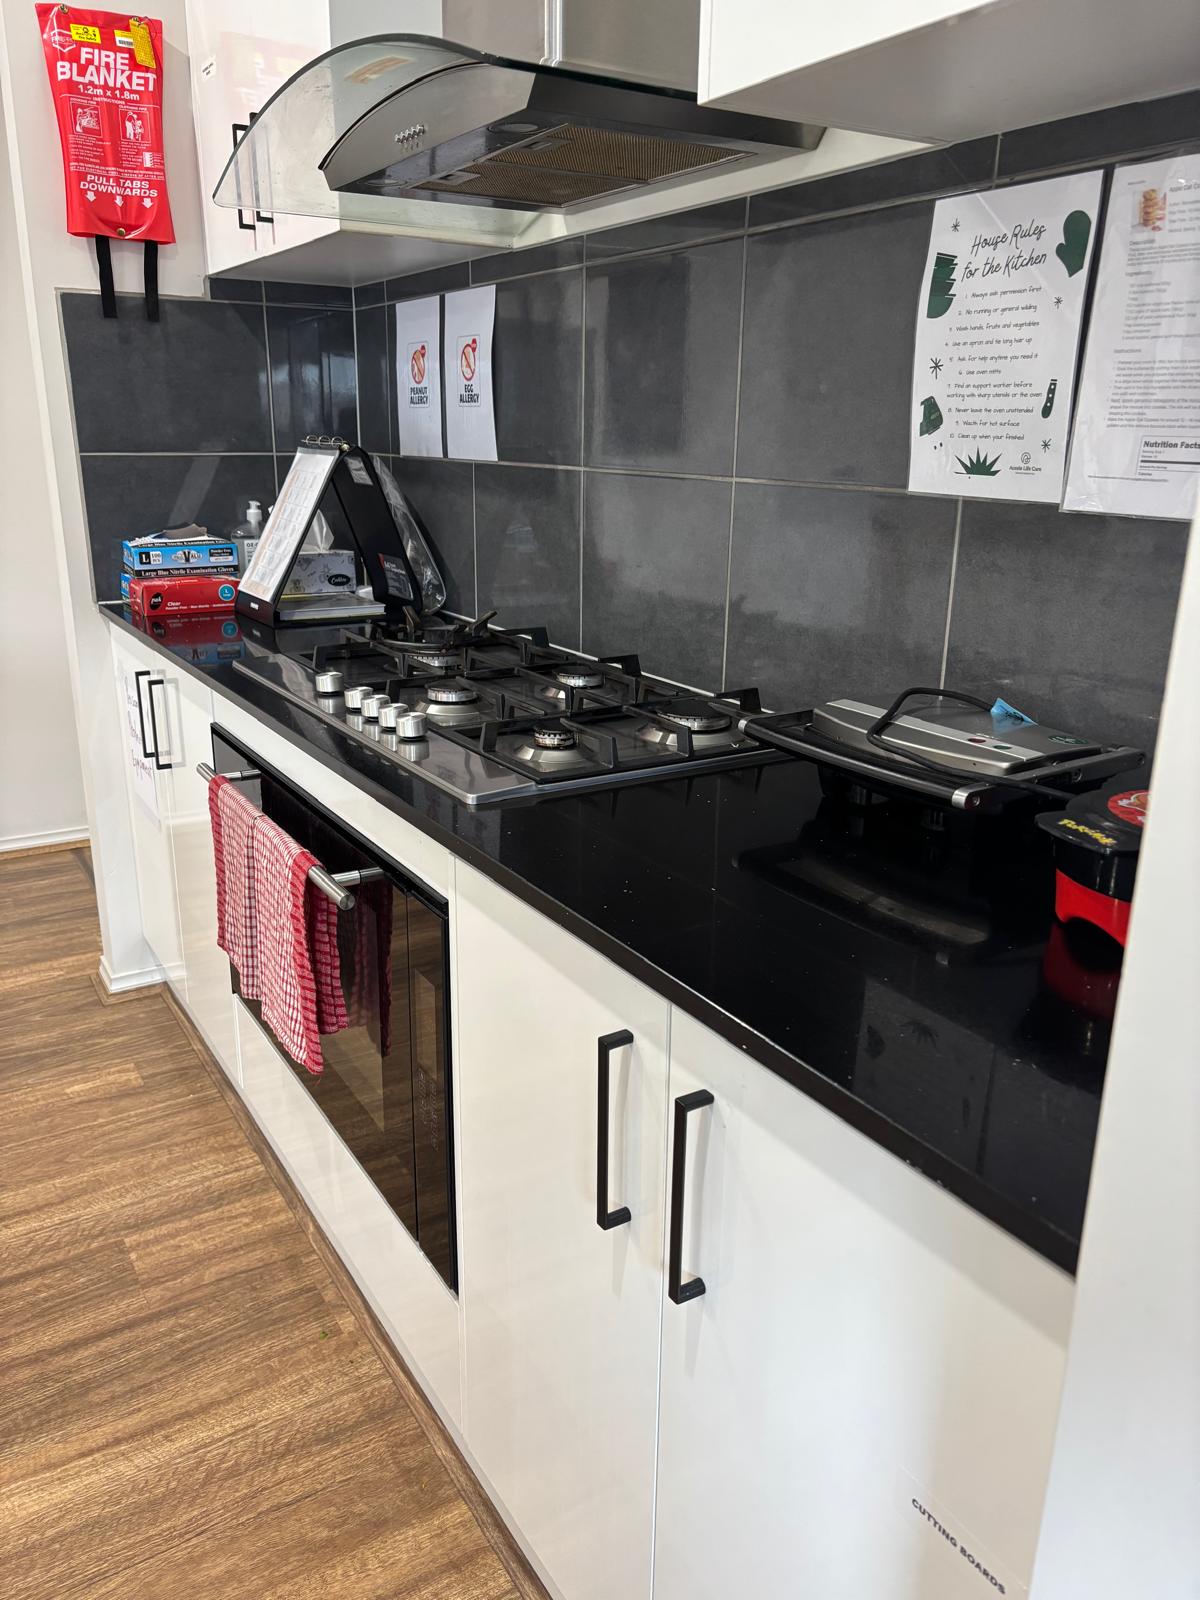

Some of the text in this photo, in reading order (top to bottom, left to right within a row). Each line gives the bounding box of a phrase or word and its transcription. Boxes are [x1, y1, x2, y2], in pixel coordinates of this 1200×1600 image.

[80, 47, 130, 70] FIRE
[56, 61, 156, 92] BLANKET
[78, 84, 103, 96] 1.2m
[115, 90, 140, 101] 1.8m
[86, 174, 149, 188] PULL TABS
[80, 181, 158, 197] DOWNWARDS
[970, 219, 1046, 256] House Rules
[961, 248, 1047, 282] for the Kitchen
[974, 308, 992, 316] running
[968, 354, 977, 362] for
[978, 355, 988, 363] help
[1010, 354, 1019, 363] you
[1020, 352, 1034, 360] need
[464, 384, 474, 393] EGG
[1014, 380, 1032, 388] before
[410, 386, 428, 396] PEANUT
[410, 396, 428, 405] ALLERGY
[460, 393, 480, 404] ALLERGY
[1006, 406, 1034, 414] unattended
[992, 434, 1004, 442] your
[1143, 440, 1200, 450] Nutrition Facts
[142, 554, 149, 562] L
[912, 1498, 1006, 1595] CUTTING BOARDS
